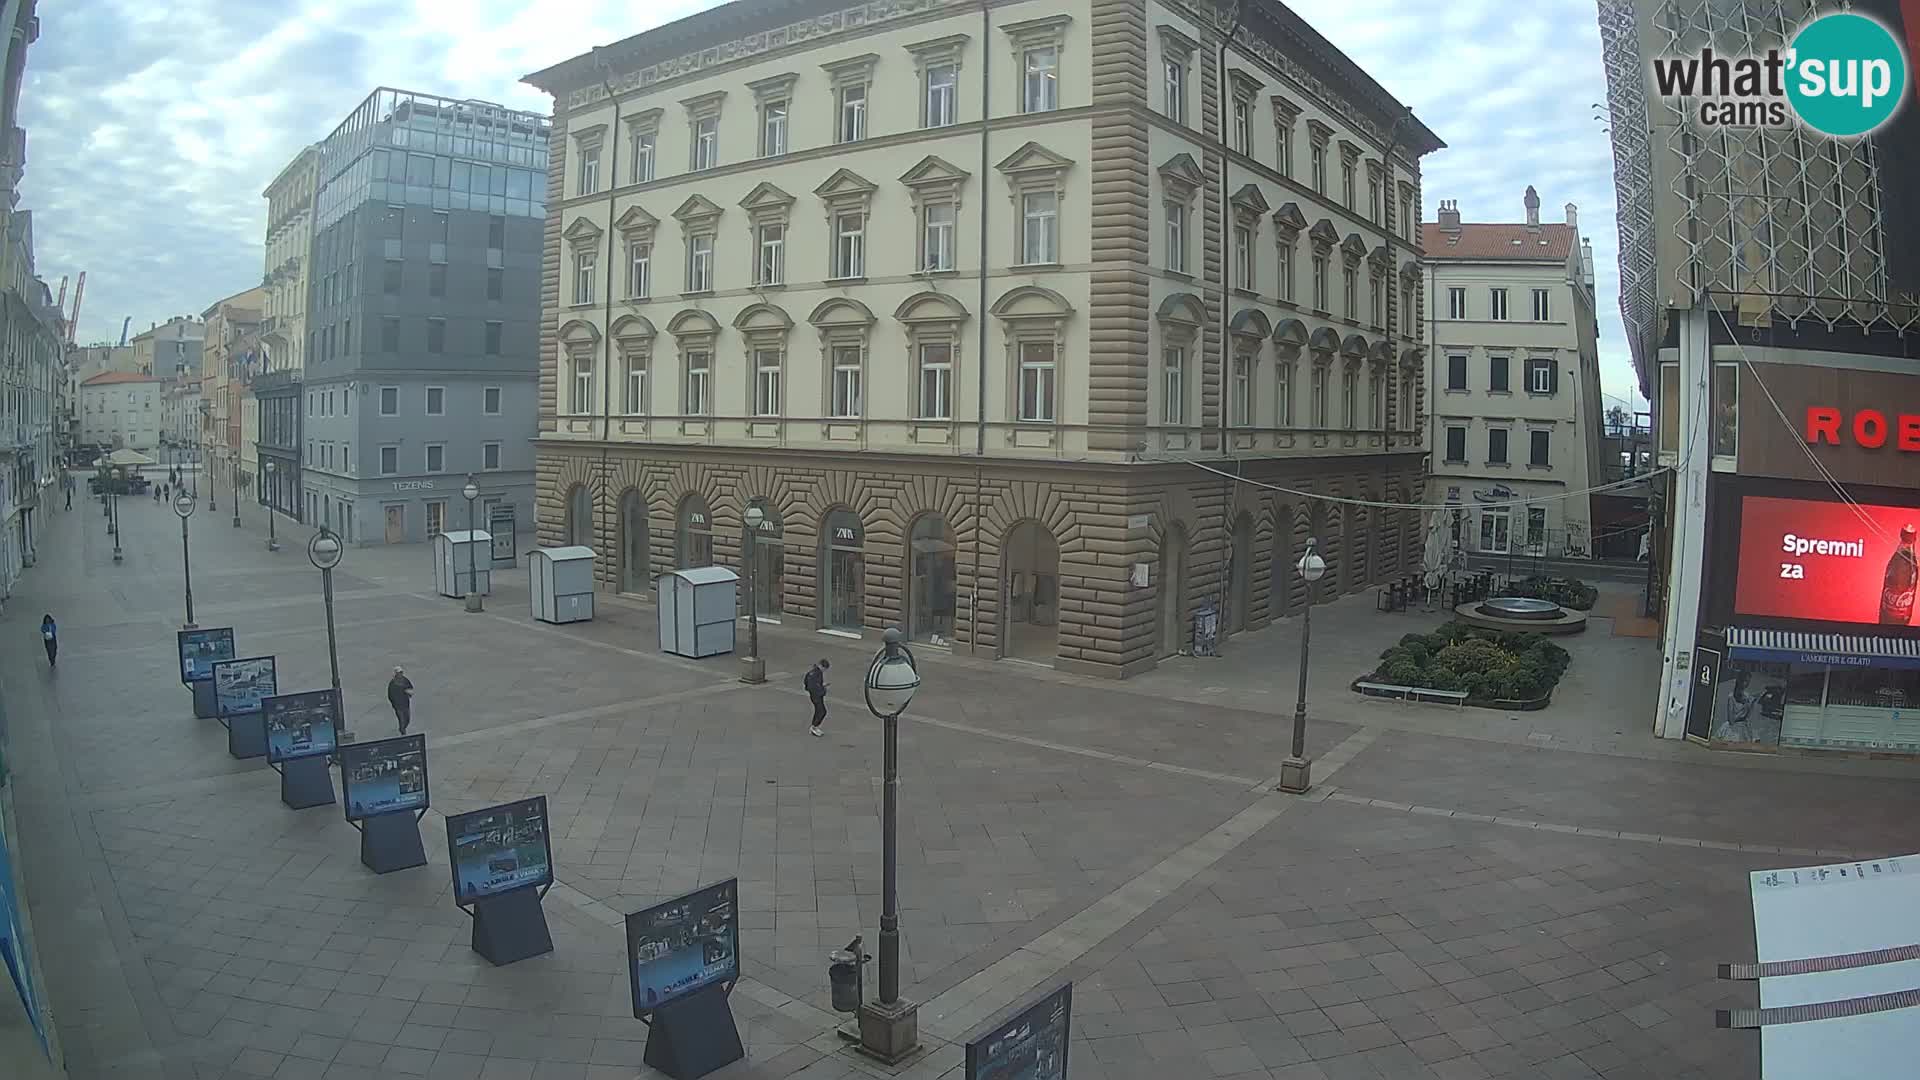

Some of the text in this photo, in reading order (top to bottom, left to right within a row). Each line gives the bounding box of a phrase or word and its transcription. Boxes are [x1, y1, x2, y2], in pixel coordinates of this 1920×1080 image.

[392, 480, 433, 491] TEZENIS
[1782, 534, 1864, 558] Spremni
[1780, 562, 1804, 579] za
[1846, 655, 1871, 666] GELATO
